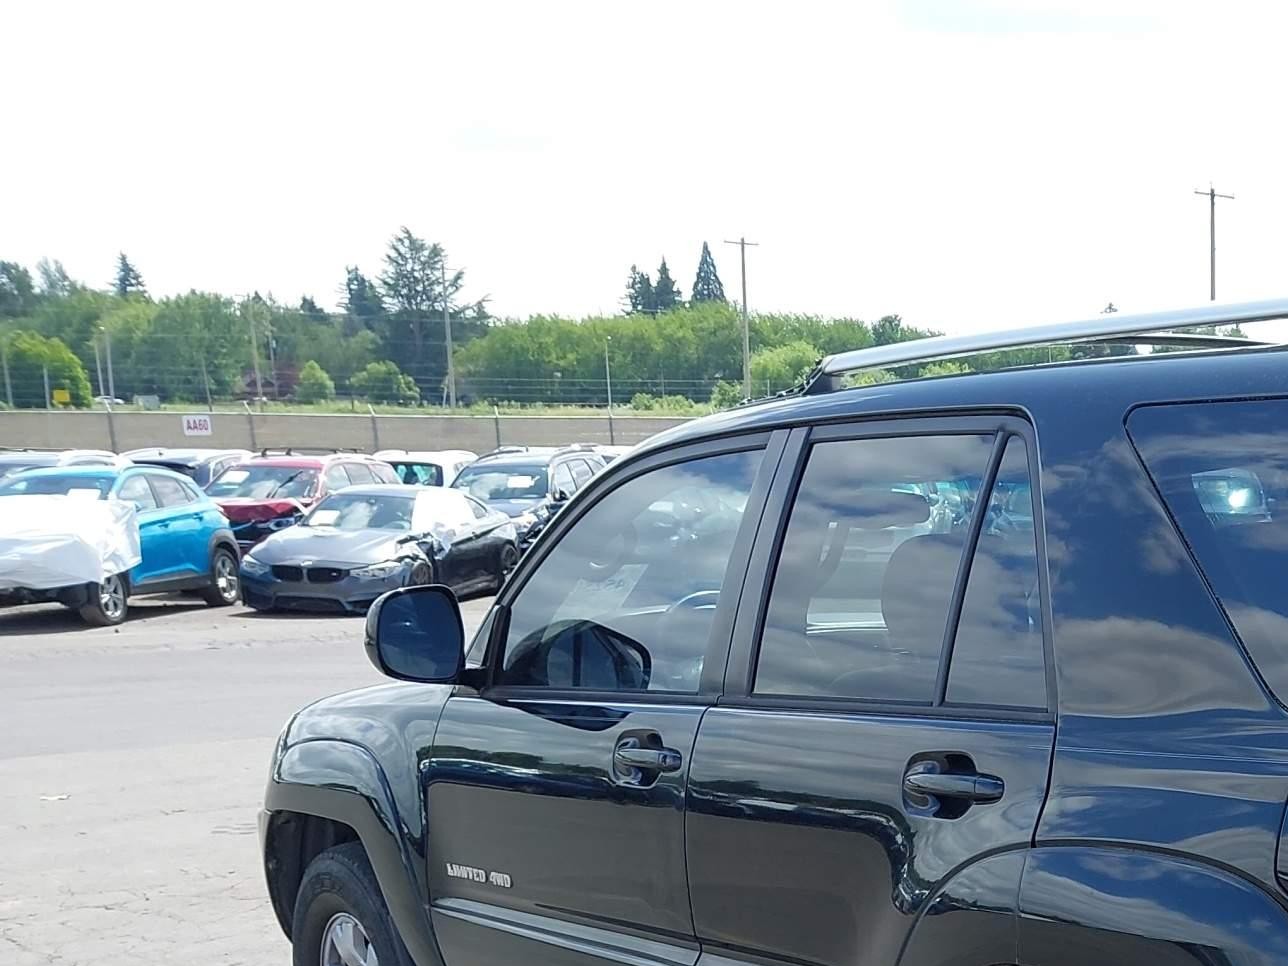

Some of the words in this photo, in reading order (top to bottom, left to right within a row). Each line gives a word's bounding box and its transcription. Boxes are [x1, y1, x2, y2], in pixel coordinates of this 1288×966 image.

[186, 419, 209, 431] AA60
[446, 863, 487, 883] LIMITED
[489, 871, 511, 888] 4WD
